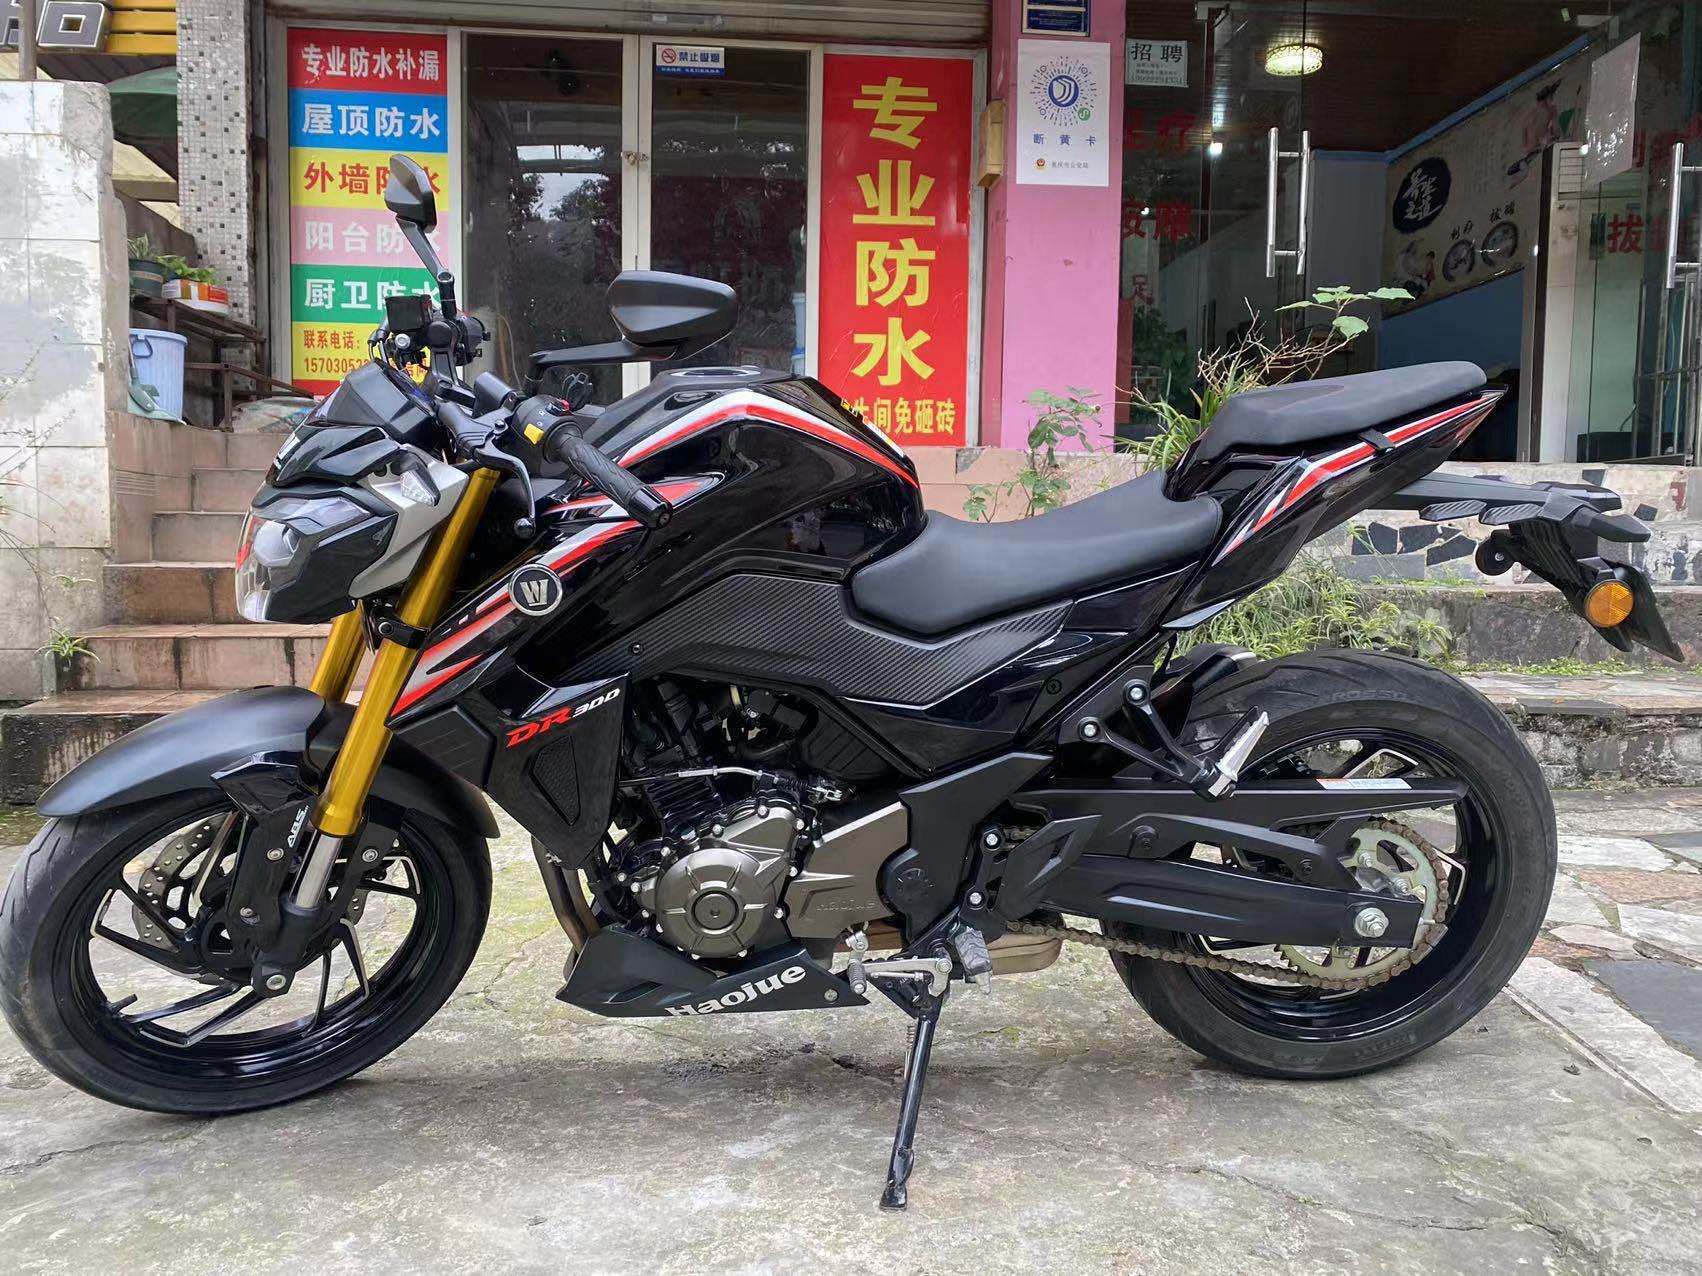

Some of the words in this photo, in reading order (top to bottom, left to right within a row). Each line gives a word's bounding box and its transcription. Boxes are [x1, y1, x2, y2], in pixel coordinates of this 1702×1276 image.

[302, 44, 440, 81] 专业防水补漏
[1130, 43, 1183, 63] 招聘
[302, 103, 441, 140] 屋顶防水
[303, 161, 441, 196] 外墙
[852, 76, 938, 386] 专业防水
[664, 965, 807, 1016] Haojue
